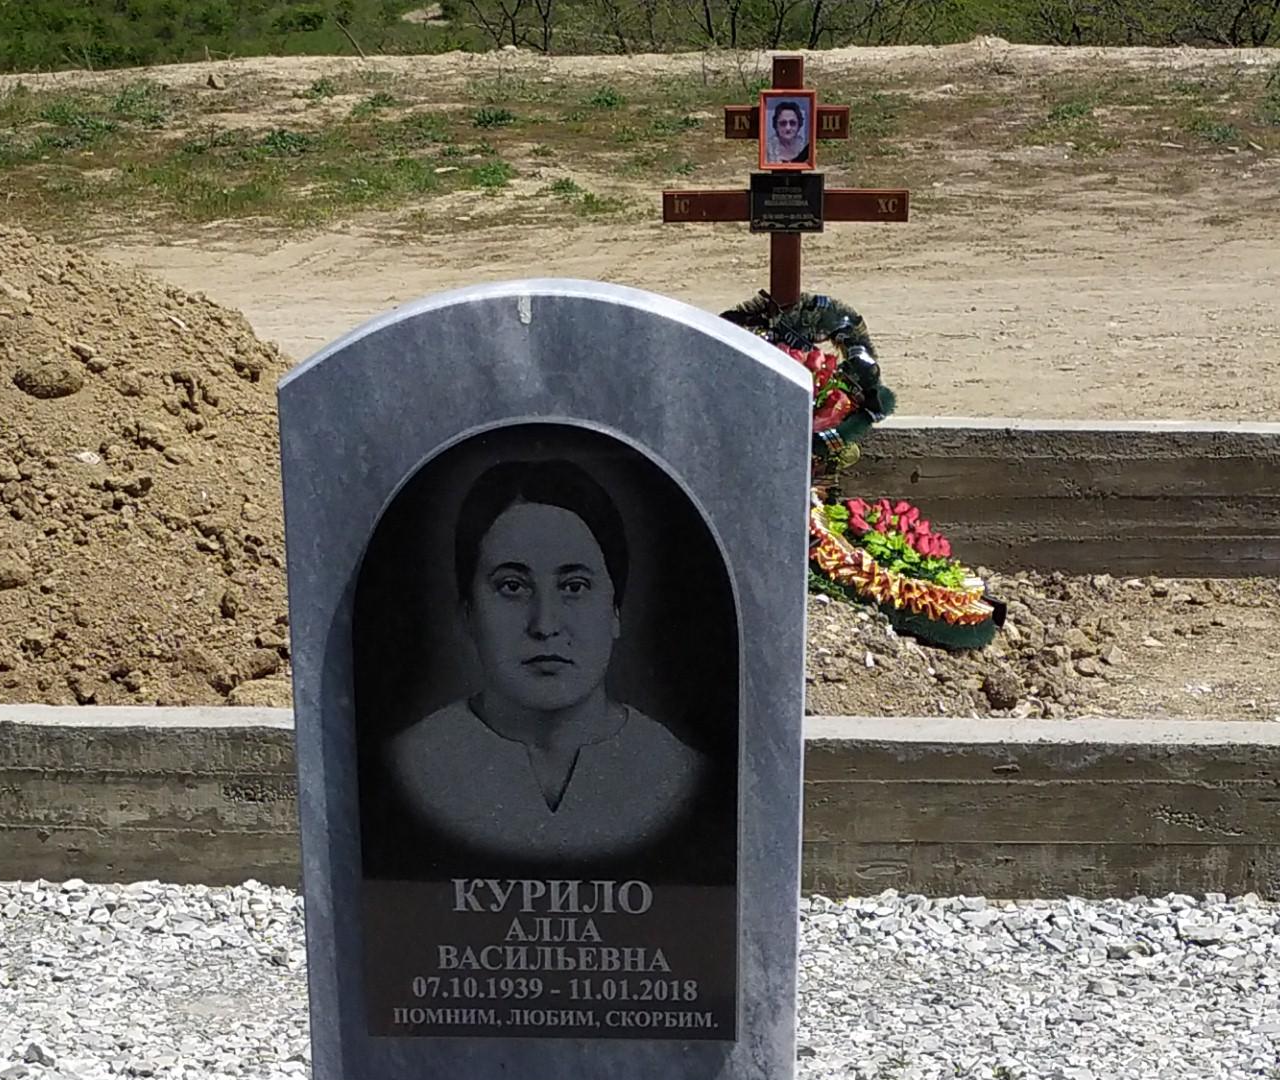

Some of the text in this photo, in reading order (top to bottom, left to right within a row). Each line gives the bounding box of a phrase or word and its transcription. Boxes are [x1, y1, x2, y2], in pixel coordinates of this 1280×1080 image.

[451, 878, 653, 914] КУРИЛО
[504, 917, 602, 943] АЛЛА
[438, 945, 671, 972] ВАСИЛЬЕВНА
[412, 976, 543, 999] 07.10.1939
[569, 978, 698, 1001] 11.01.2018
[393, 1007, 719, 1029] ПОМНИМ, ЛЮБИМ, СКОРБИМ.
